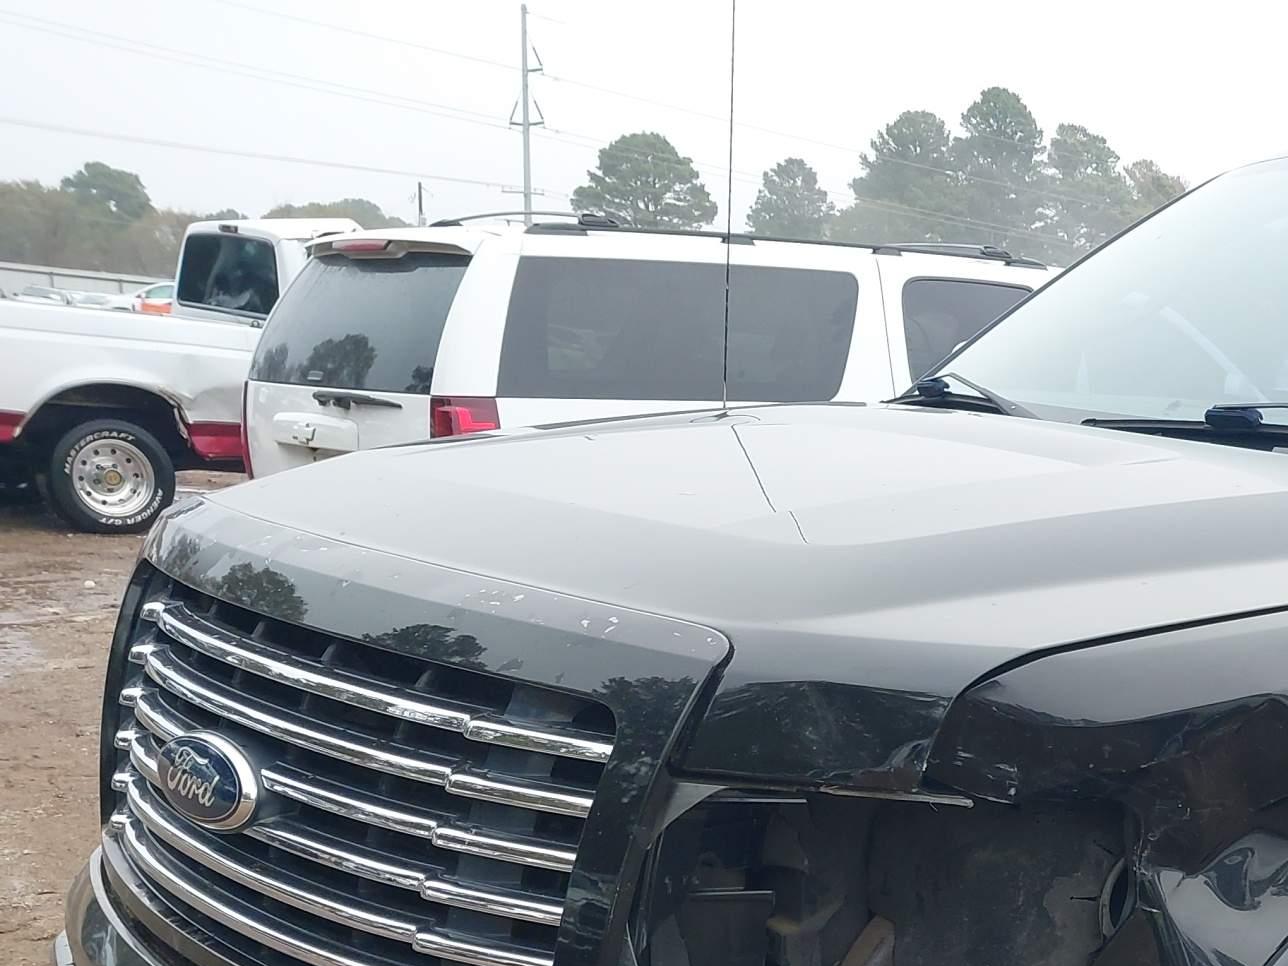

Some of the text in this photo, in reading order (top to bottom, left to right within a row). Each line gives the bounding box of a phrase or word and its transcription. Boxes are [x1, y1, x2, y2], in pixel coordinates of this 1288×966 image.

[64, 431, 135, 474] MASTERCRAFT
[128, 488, 164, 525] AVENGER
[167, 746, 220, 807] Ford
